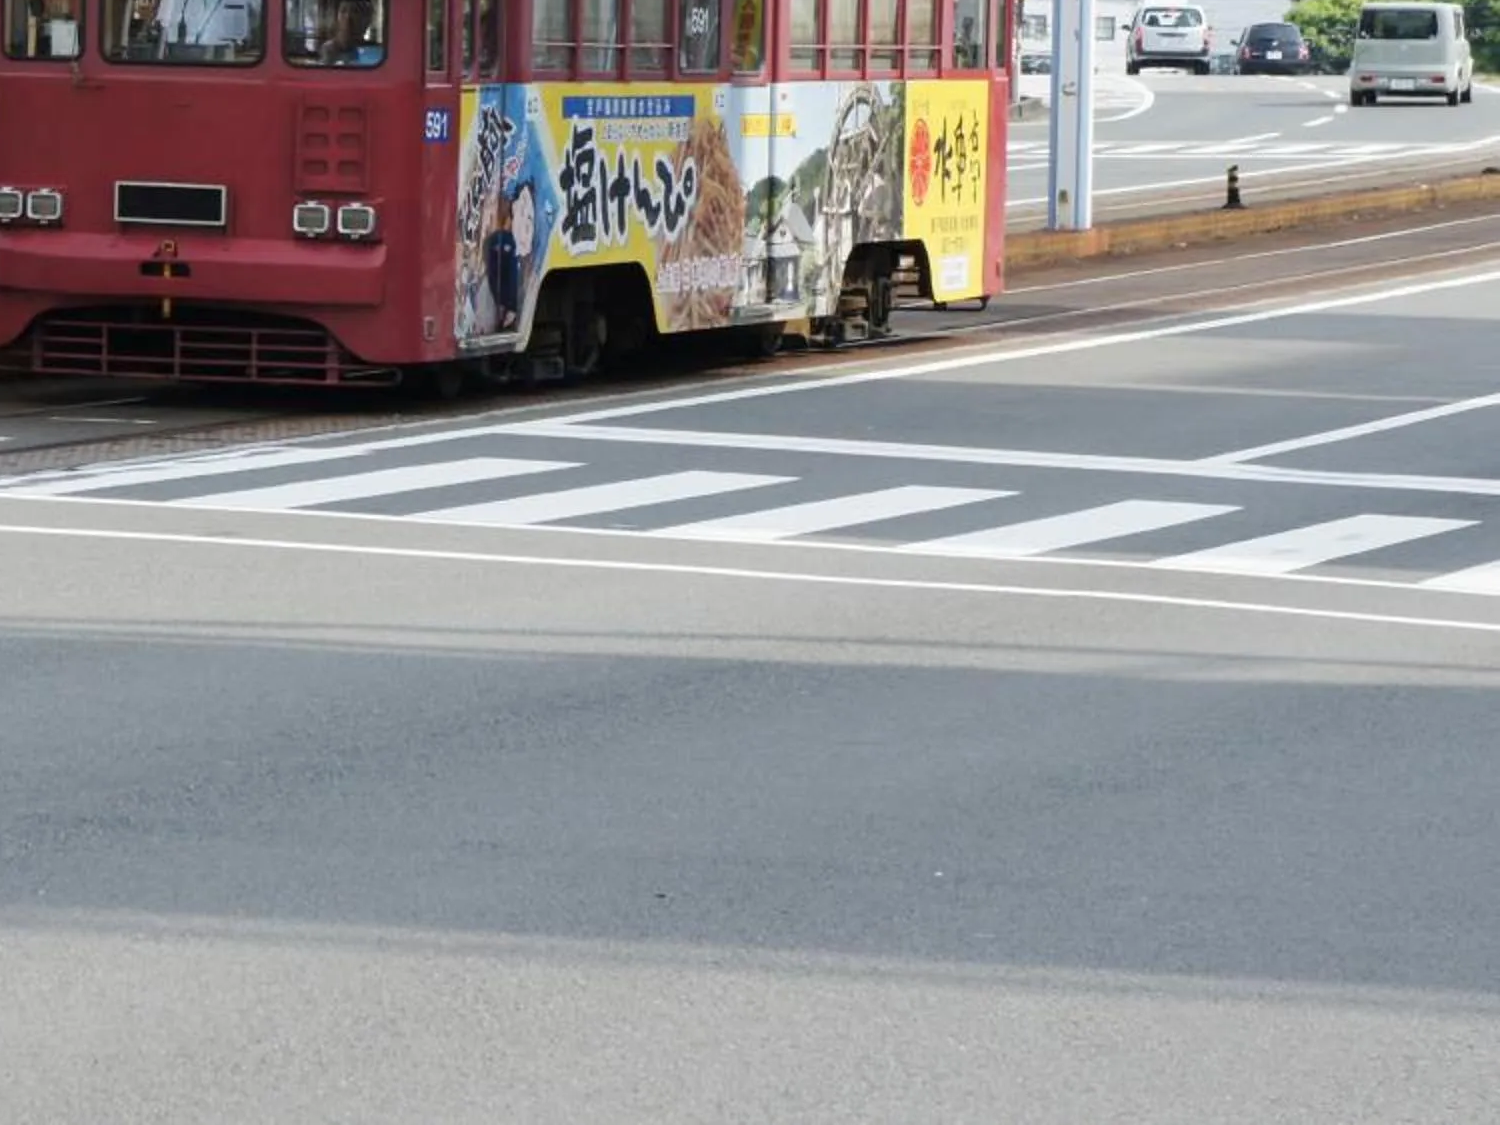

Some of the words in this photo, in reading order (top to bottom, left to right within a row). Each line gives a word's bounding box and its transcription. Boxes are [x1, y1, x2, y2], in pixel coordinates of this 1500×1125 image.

[426, 112, 448, 138] 591
[560, 124, 694, 242] 塩けんぴ
